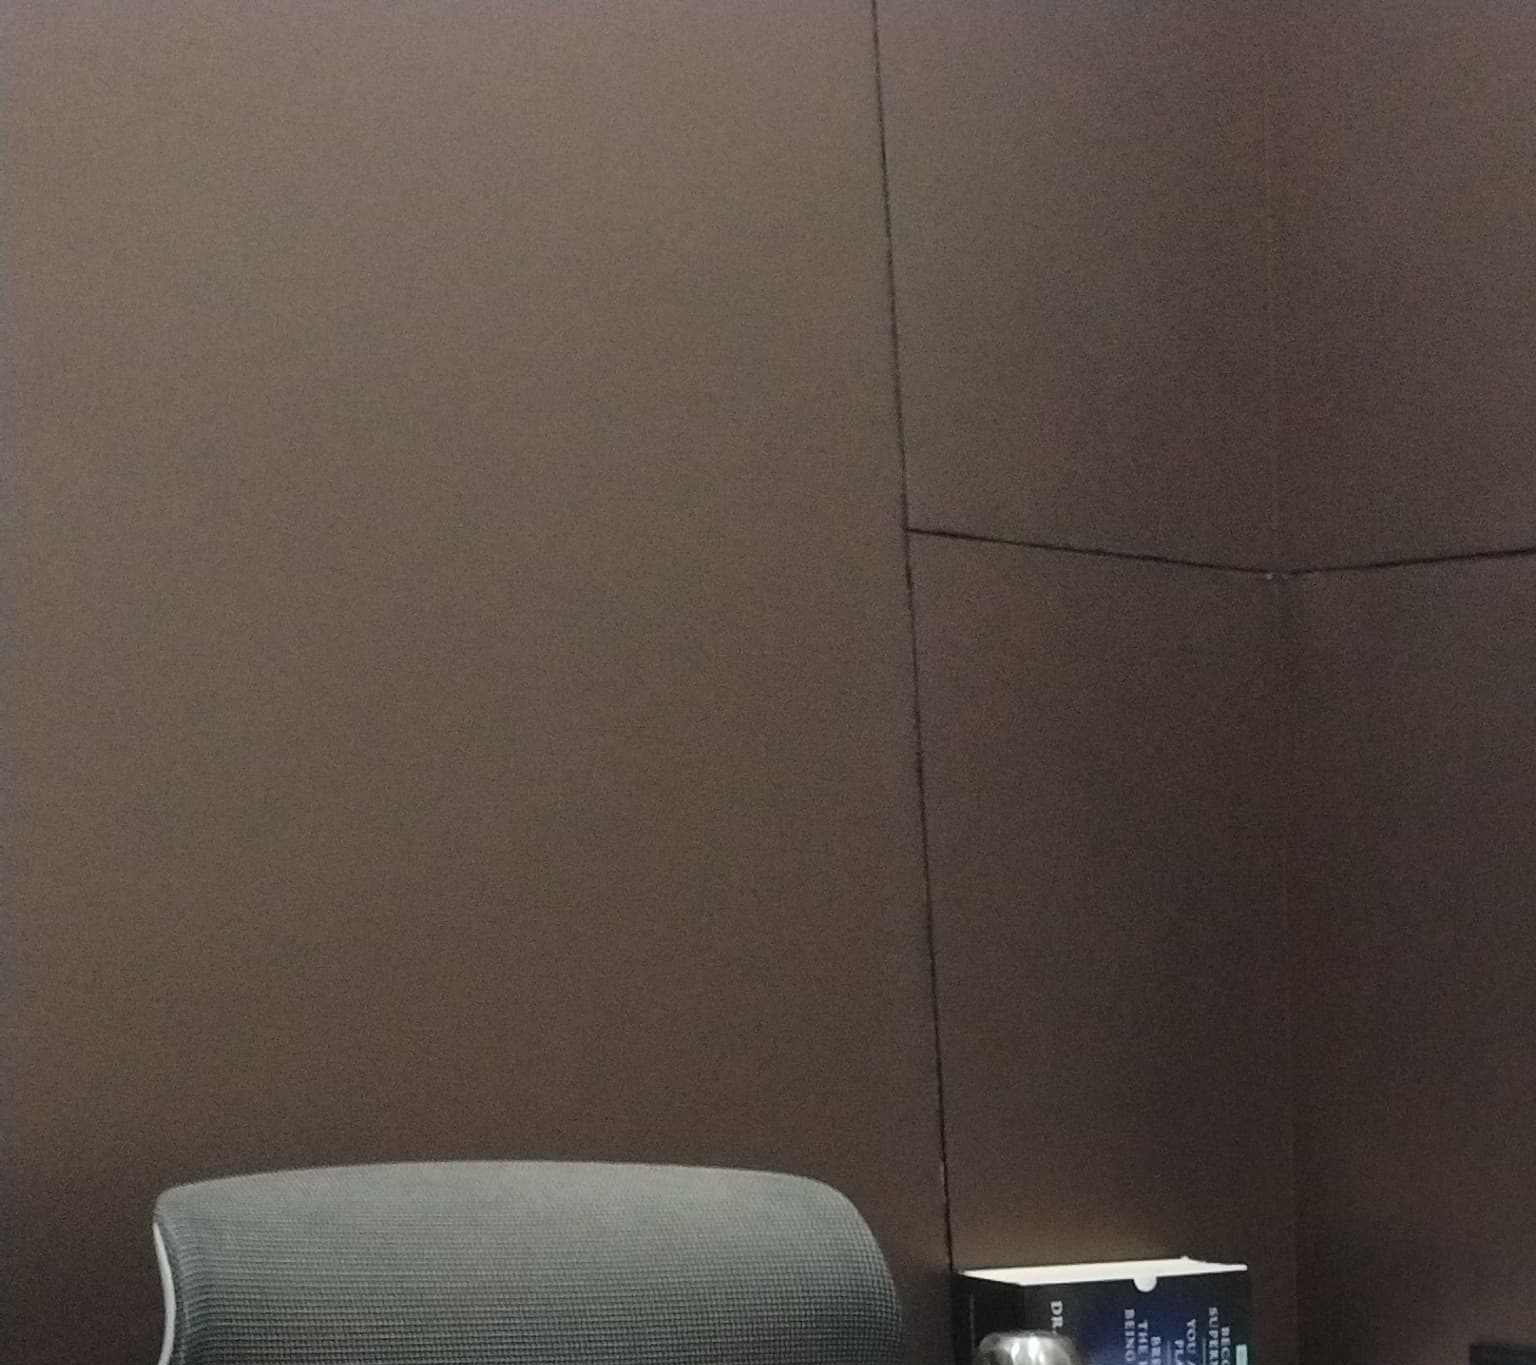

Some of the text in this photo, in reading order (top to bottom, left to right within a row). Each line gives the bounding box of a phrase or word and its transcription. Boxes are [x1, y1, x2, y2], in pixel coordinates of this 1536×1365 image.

[1123, 1308, 1136, 1363] BEING
[1137, 1320, 1149, 1356] THE
[1186, 1318, 1197, 1355] YOU
